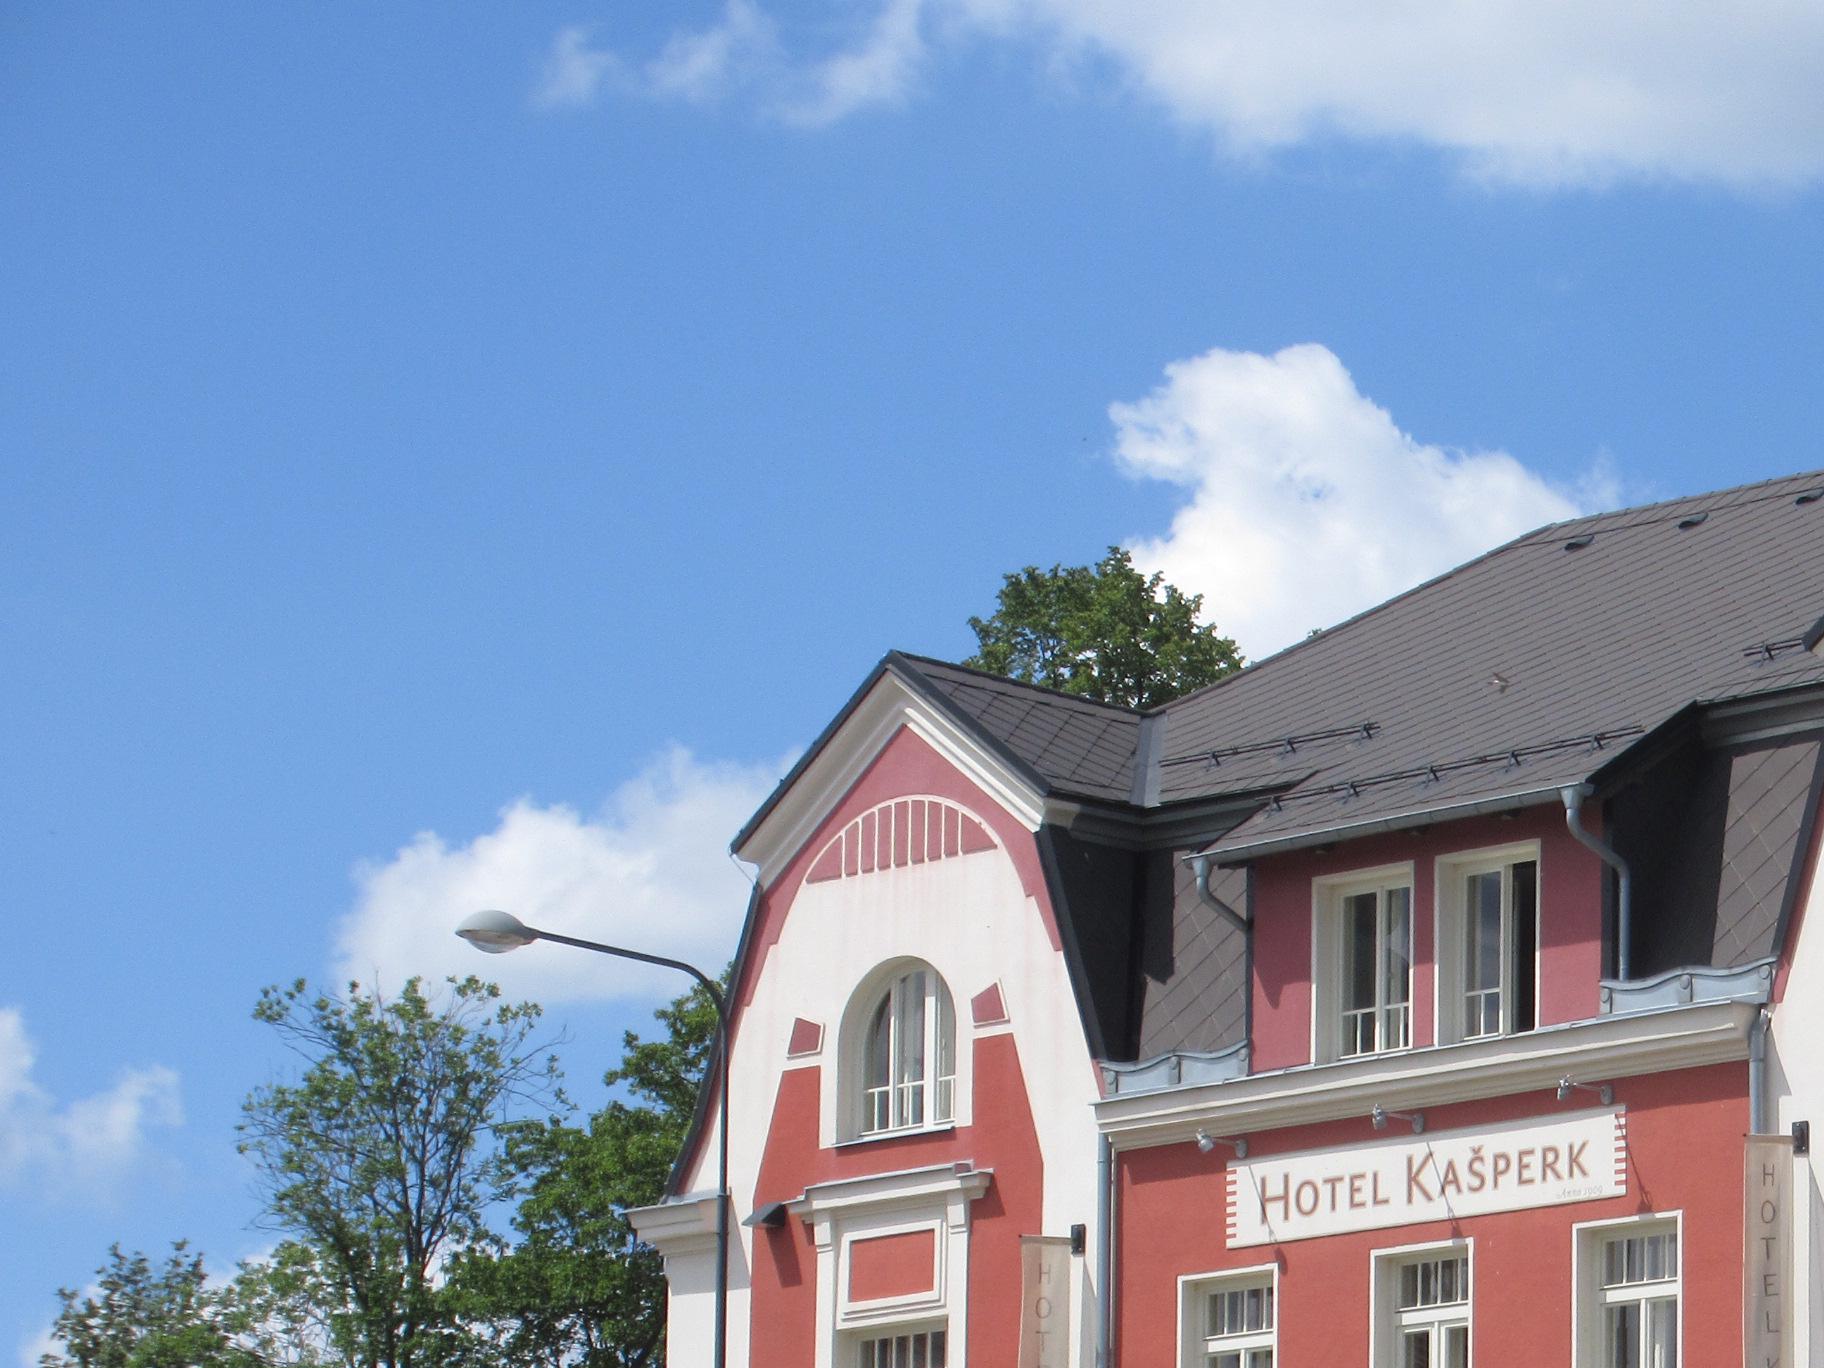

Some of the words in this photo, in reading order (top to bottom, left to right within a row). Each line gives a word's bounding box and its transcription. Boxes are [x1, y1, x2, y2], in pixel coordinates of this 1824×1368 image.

[1259, 1170, 1390, 1225] HOTEL
[1406, 1139, 1590, 1207] KAŠPERK
[1760, 1163, 1779, 1334] HOTEL
